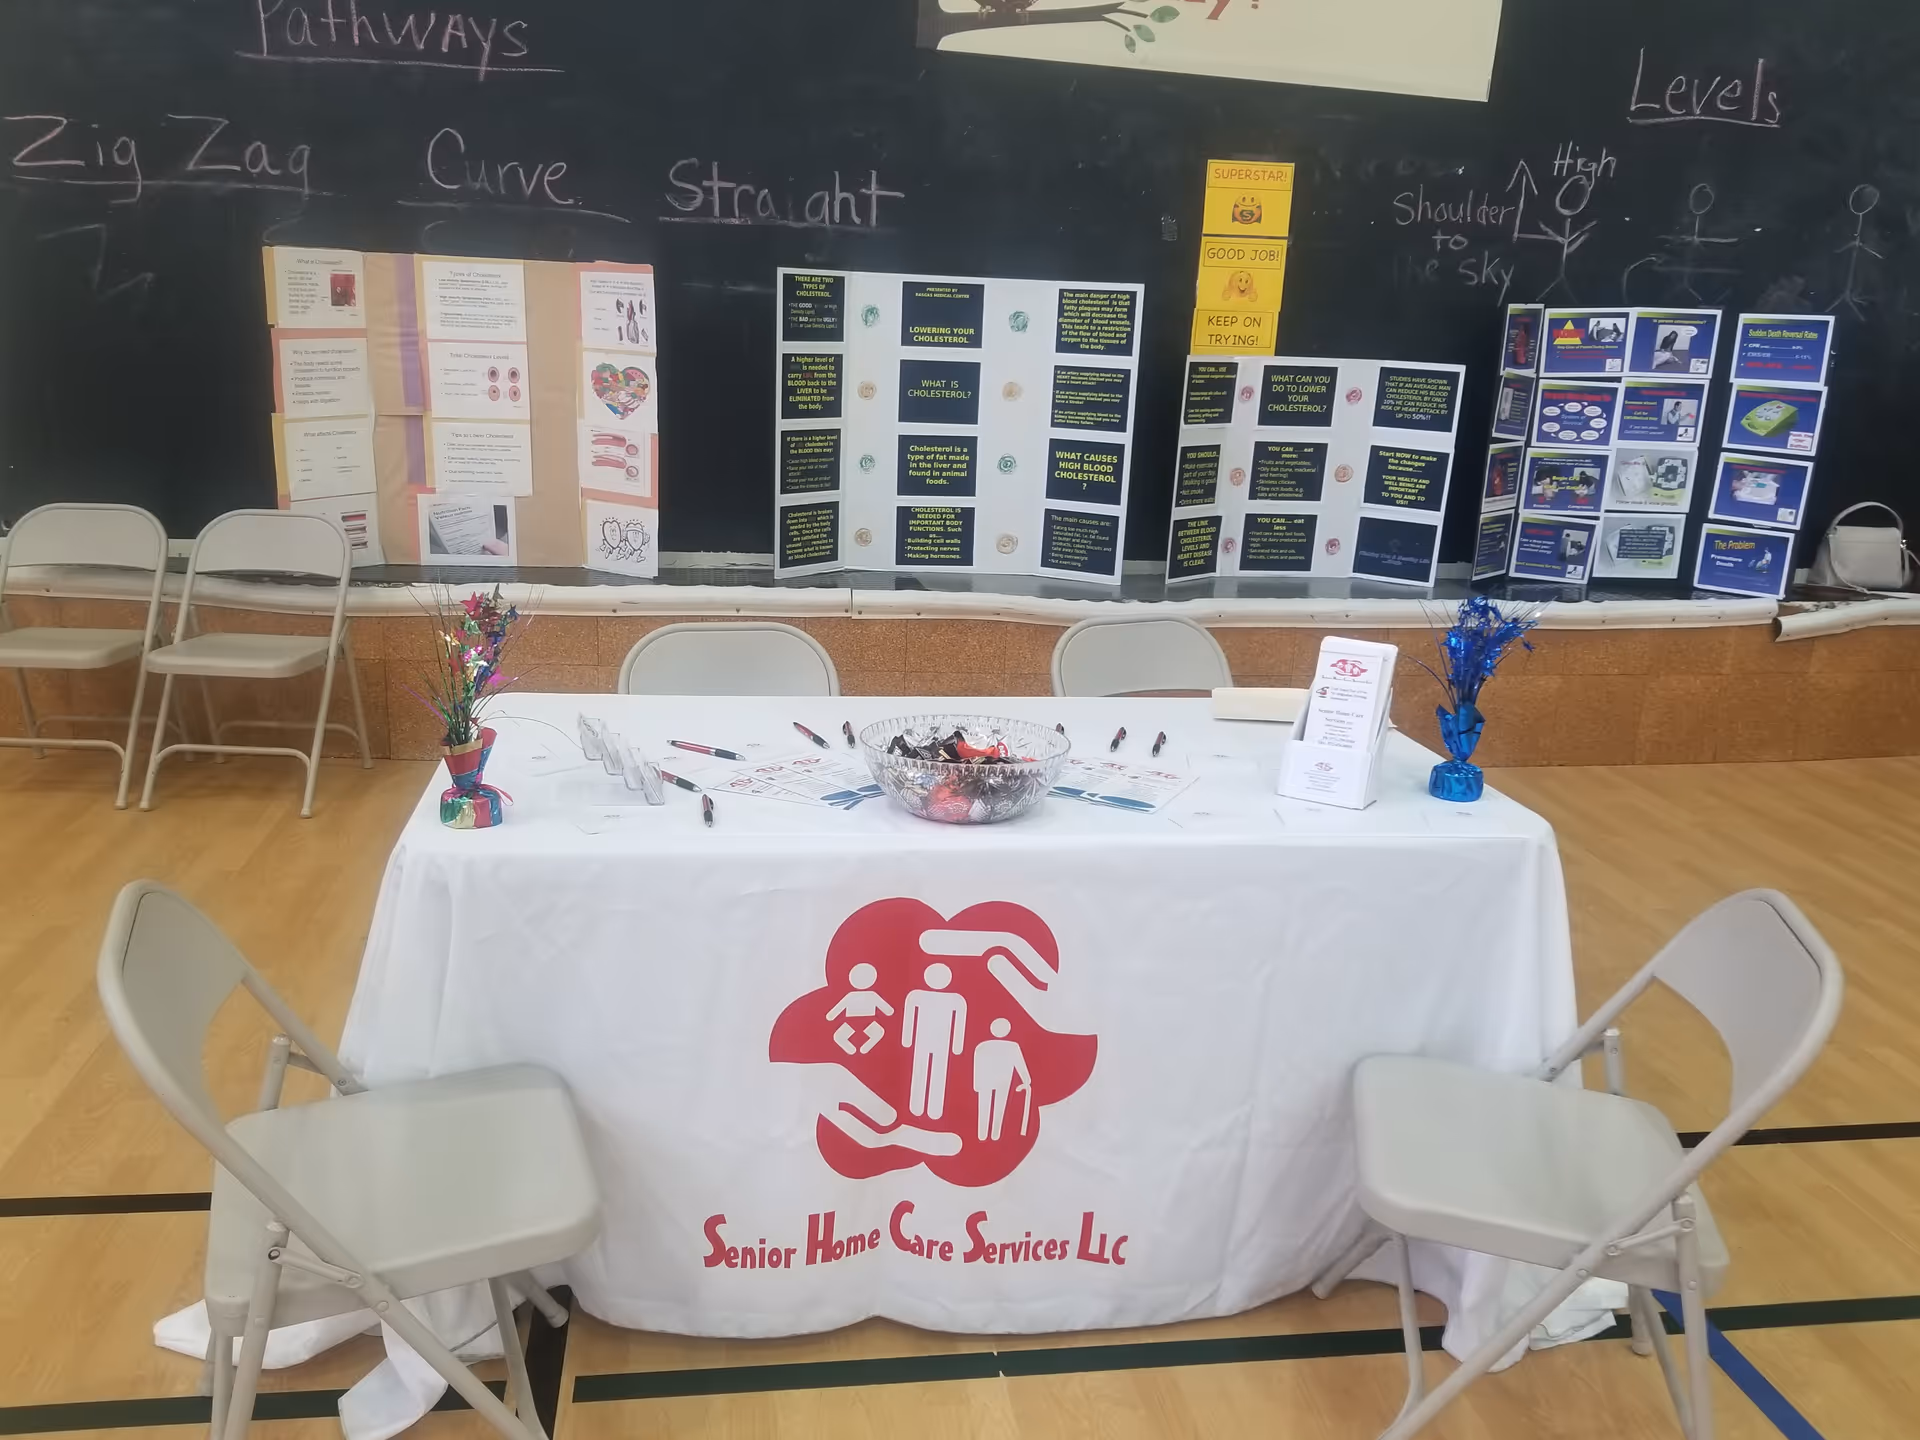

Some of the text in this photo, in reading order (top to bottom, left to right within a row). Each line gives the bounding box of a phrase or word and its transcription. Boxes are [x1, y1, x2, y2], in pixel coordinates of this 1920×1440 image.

[1630, 46, 1780, 123] Levels
[3, 114, 311, 203] Zig Zag
[1554, 140, 1616, 191] High
[1214, 168, 1288, 182] SUPERSTAR!
[1393, 184, 1515, 225] Shoulder
[1432, 229, 1468, 252] to
[1207, 248, 1280, 261] GOOD JOB!
[1207, 315, 1261, 328] KEEP ON
[1207, 334, 1258, 346] TRYING!
[908, 390, 971, 398] CHOLESTEROL?
[1083, 454, 1117, 462] CAUSES
[1082, 464, 1113, 472] BLOOD
[1055, 472, 1116, 482] CHOLESTEROL
[1715, 541, 1755, 549] The Problem
[703, 1200, 1129, 1269] Senior Home Care Services LLC
